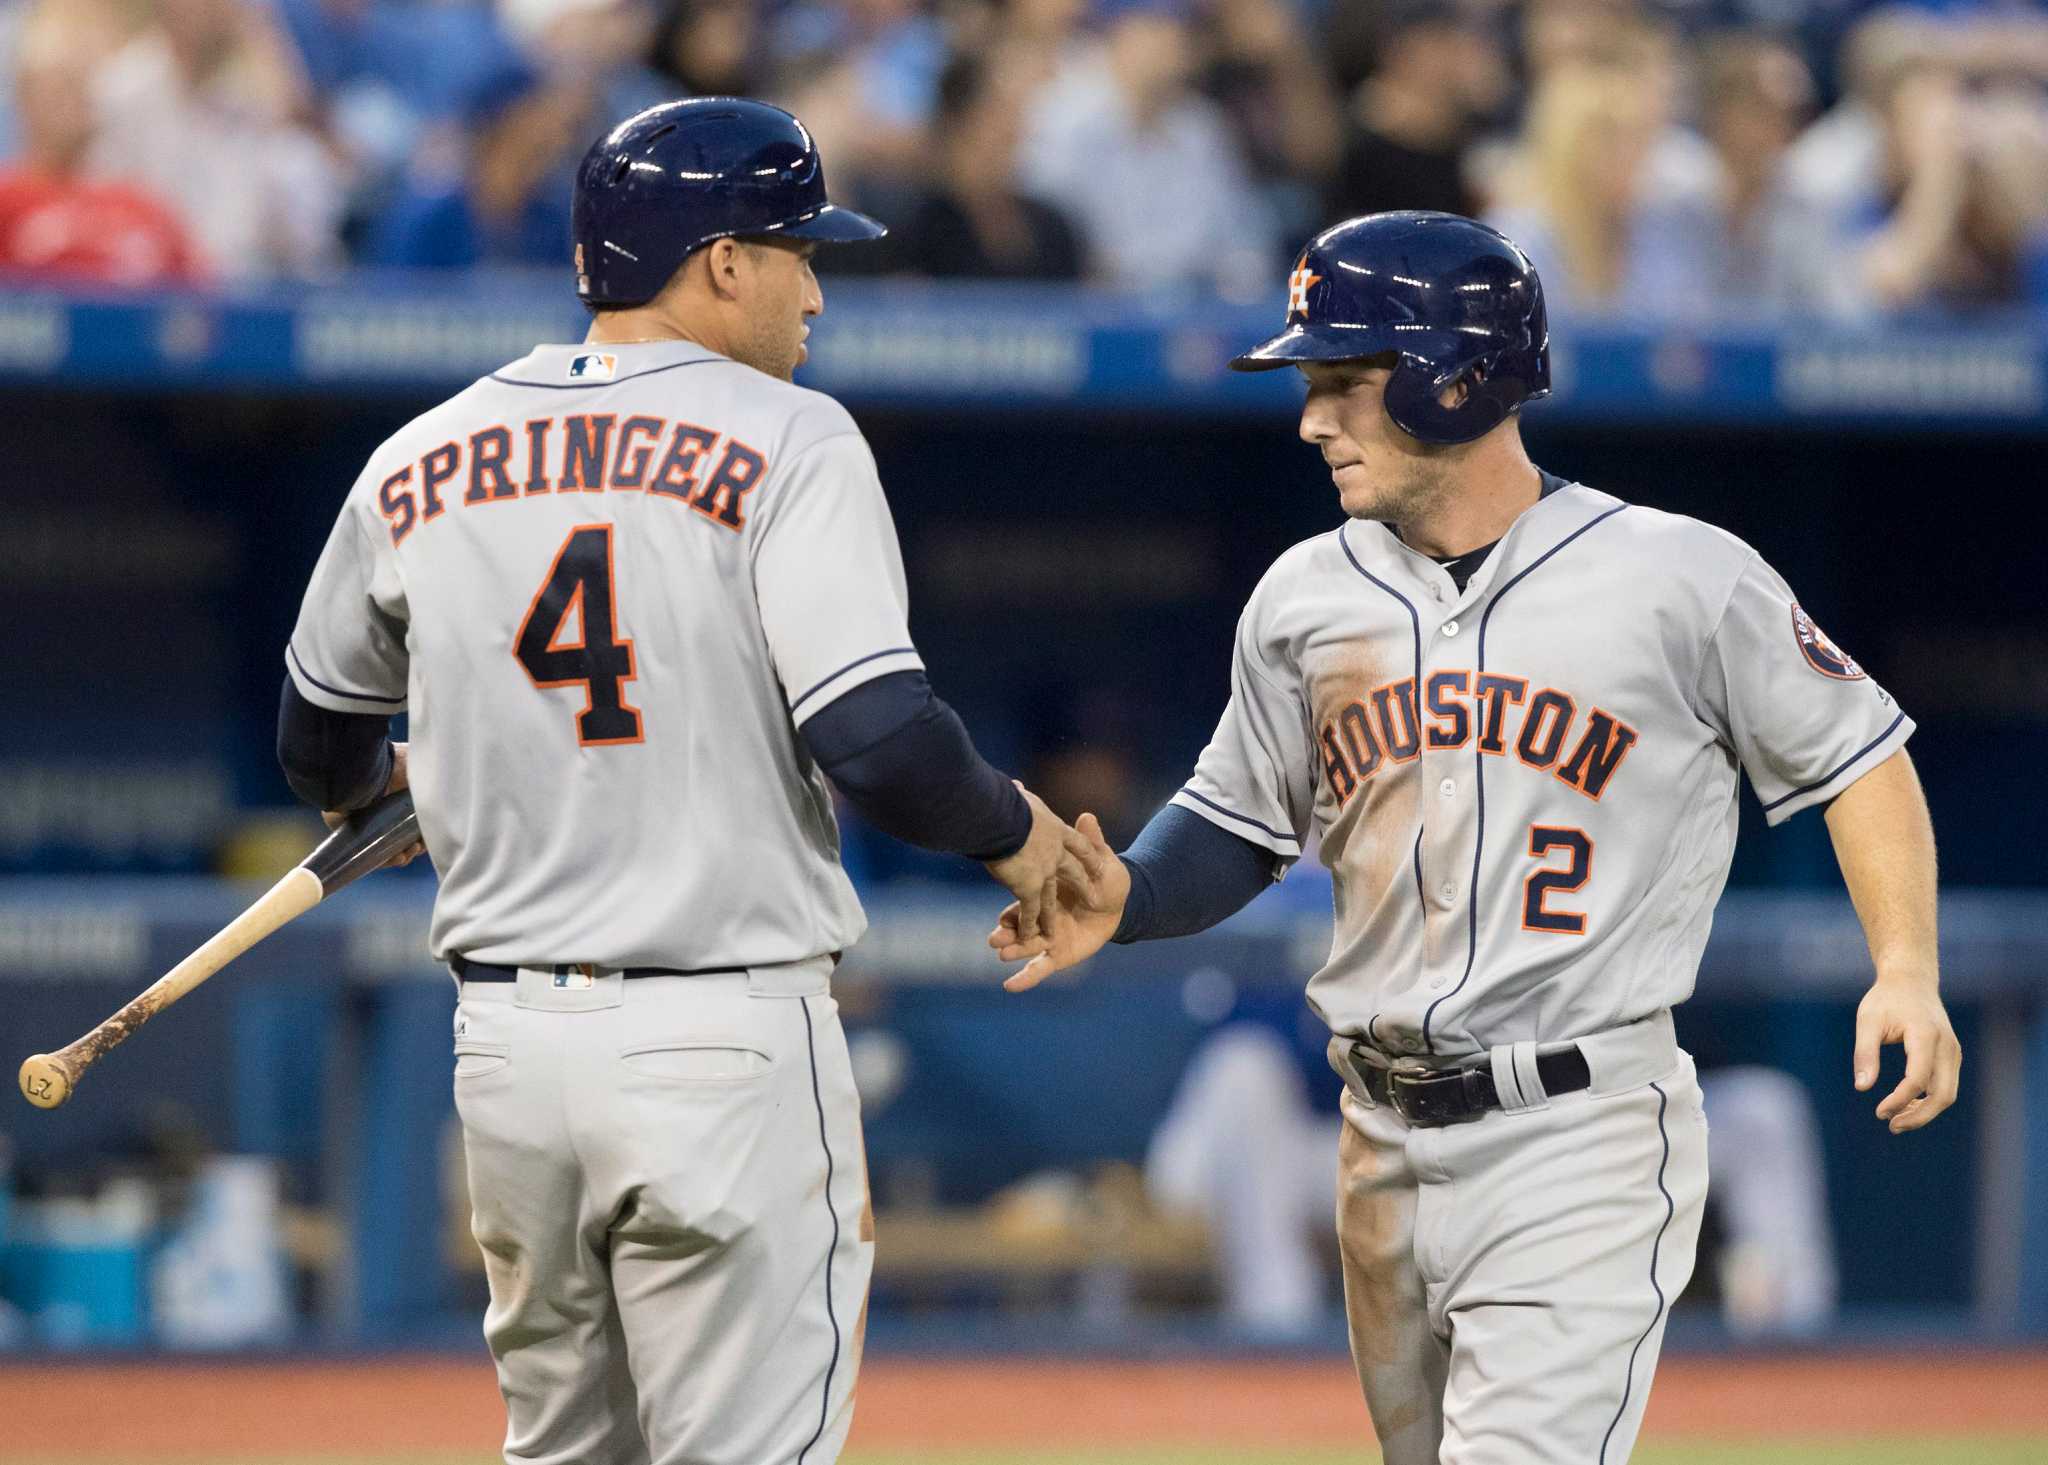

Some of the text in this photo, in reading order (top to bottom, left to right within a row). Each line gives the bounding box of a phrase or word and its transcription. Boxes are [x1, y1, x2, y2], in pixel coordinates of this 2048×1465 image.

[379, 413, 768, 549] SPRINGER
[512, 523, 645, 747] 4
[1319, 669, 1640, 810] HOUSTON
[1522, 824, 1594, 936] 2
